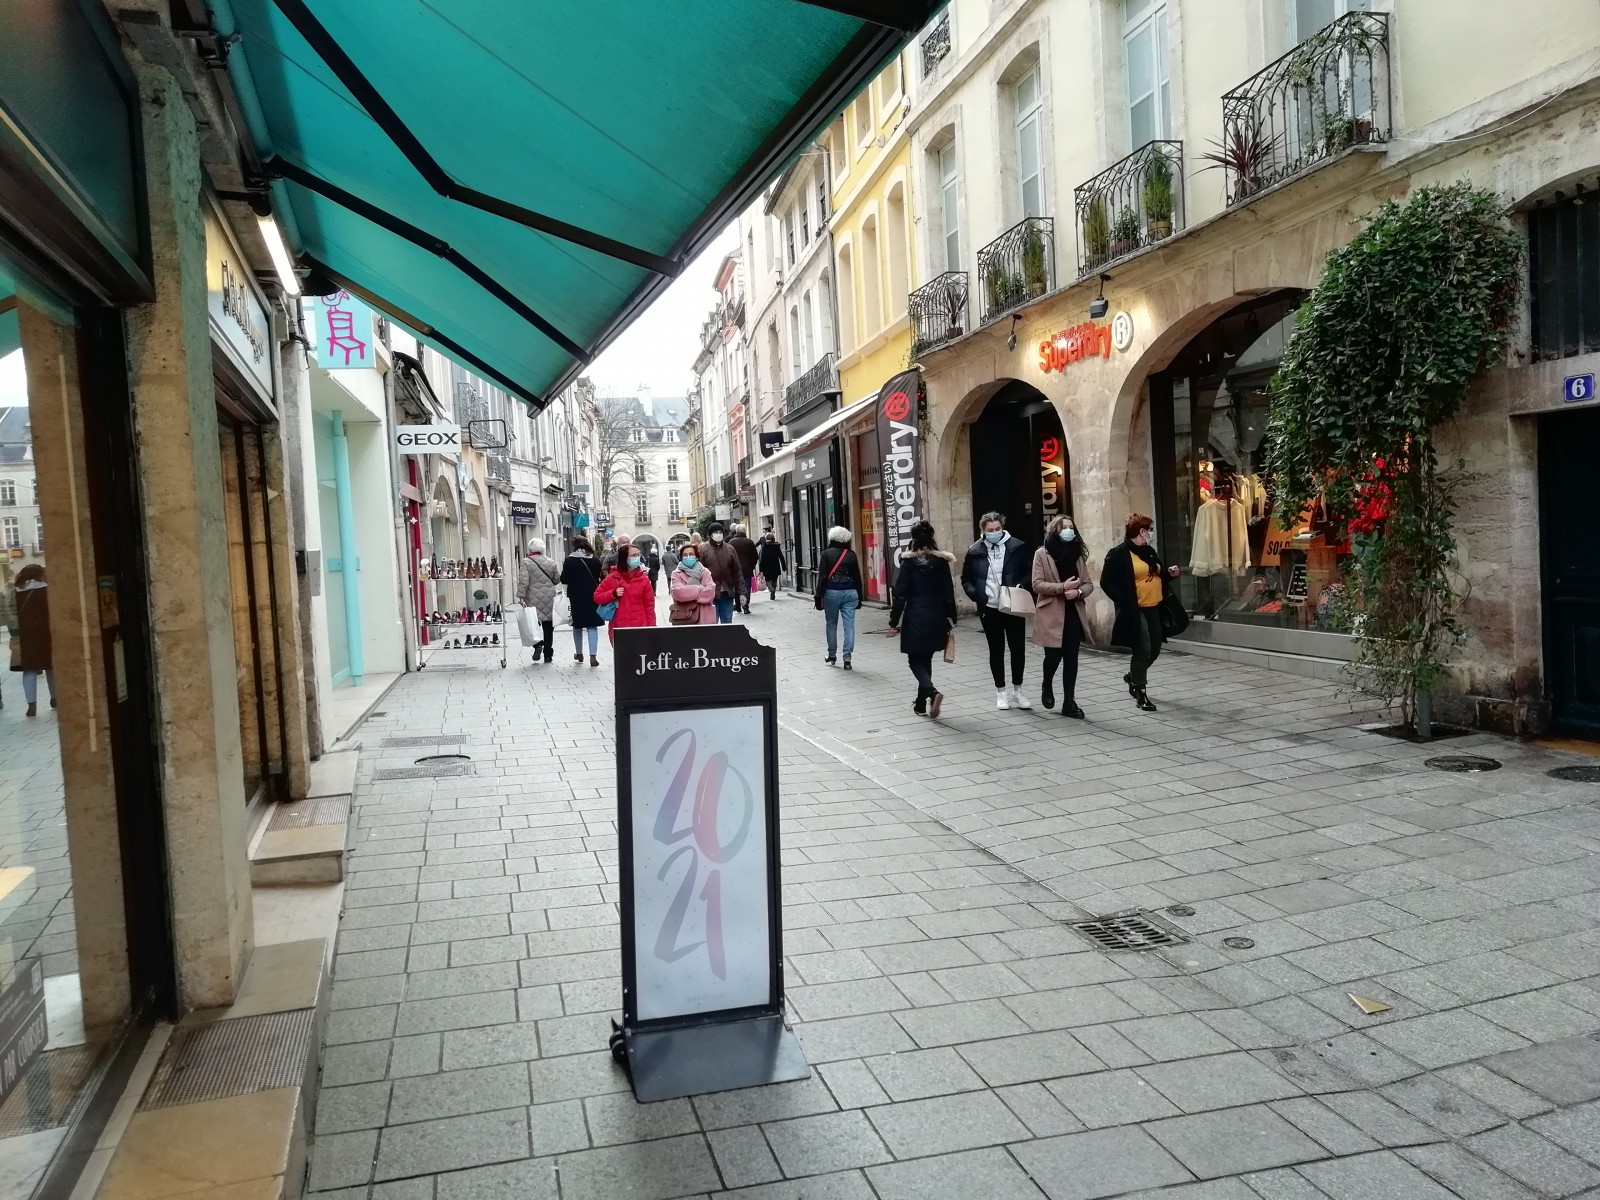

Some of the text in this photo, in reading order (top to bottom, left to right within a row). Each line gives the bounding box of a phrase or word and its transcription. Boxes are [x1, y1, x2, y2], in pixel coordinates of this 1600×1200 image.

[1039, 322, 1112, 373] Superdry
[1571, 378, 1586, 398] 6
[397, 432, 459, 446] GEOX
[636, 647, 759, 676] Jeff de Bruges
